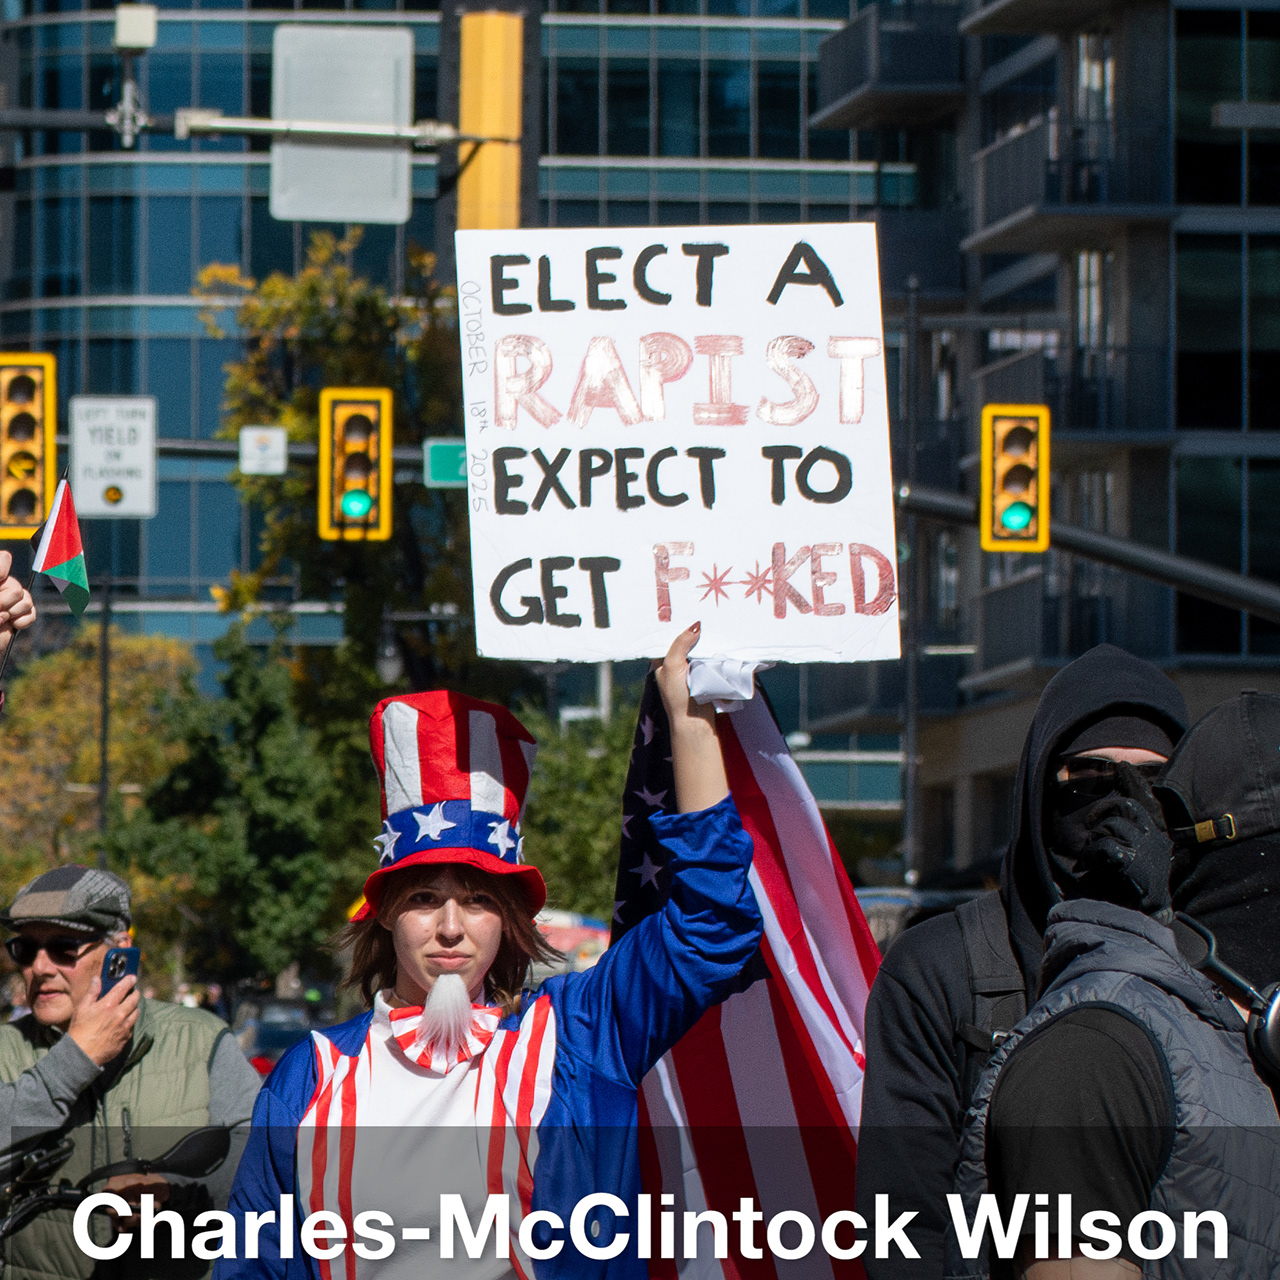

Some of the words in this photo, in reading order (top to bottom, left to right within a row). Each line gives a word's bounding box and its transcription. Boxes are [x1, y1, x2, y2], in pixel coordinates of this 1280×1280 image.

[490, 241, 729, 316] ELECT
[767, 241, 844, 307] A
[461, 280, 488, 377] OCTOBER
[494, 332, 881, 429] RAPIST
[470, 452, 489, 512] 2025
[493, 447, 726, 515] EXPECT
[762, 445, 852, 505] TO
[490, 556, 620, 628] GET
